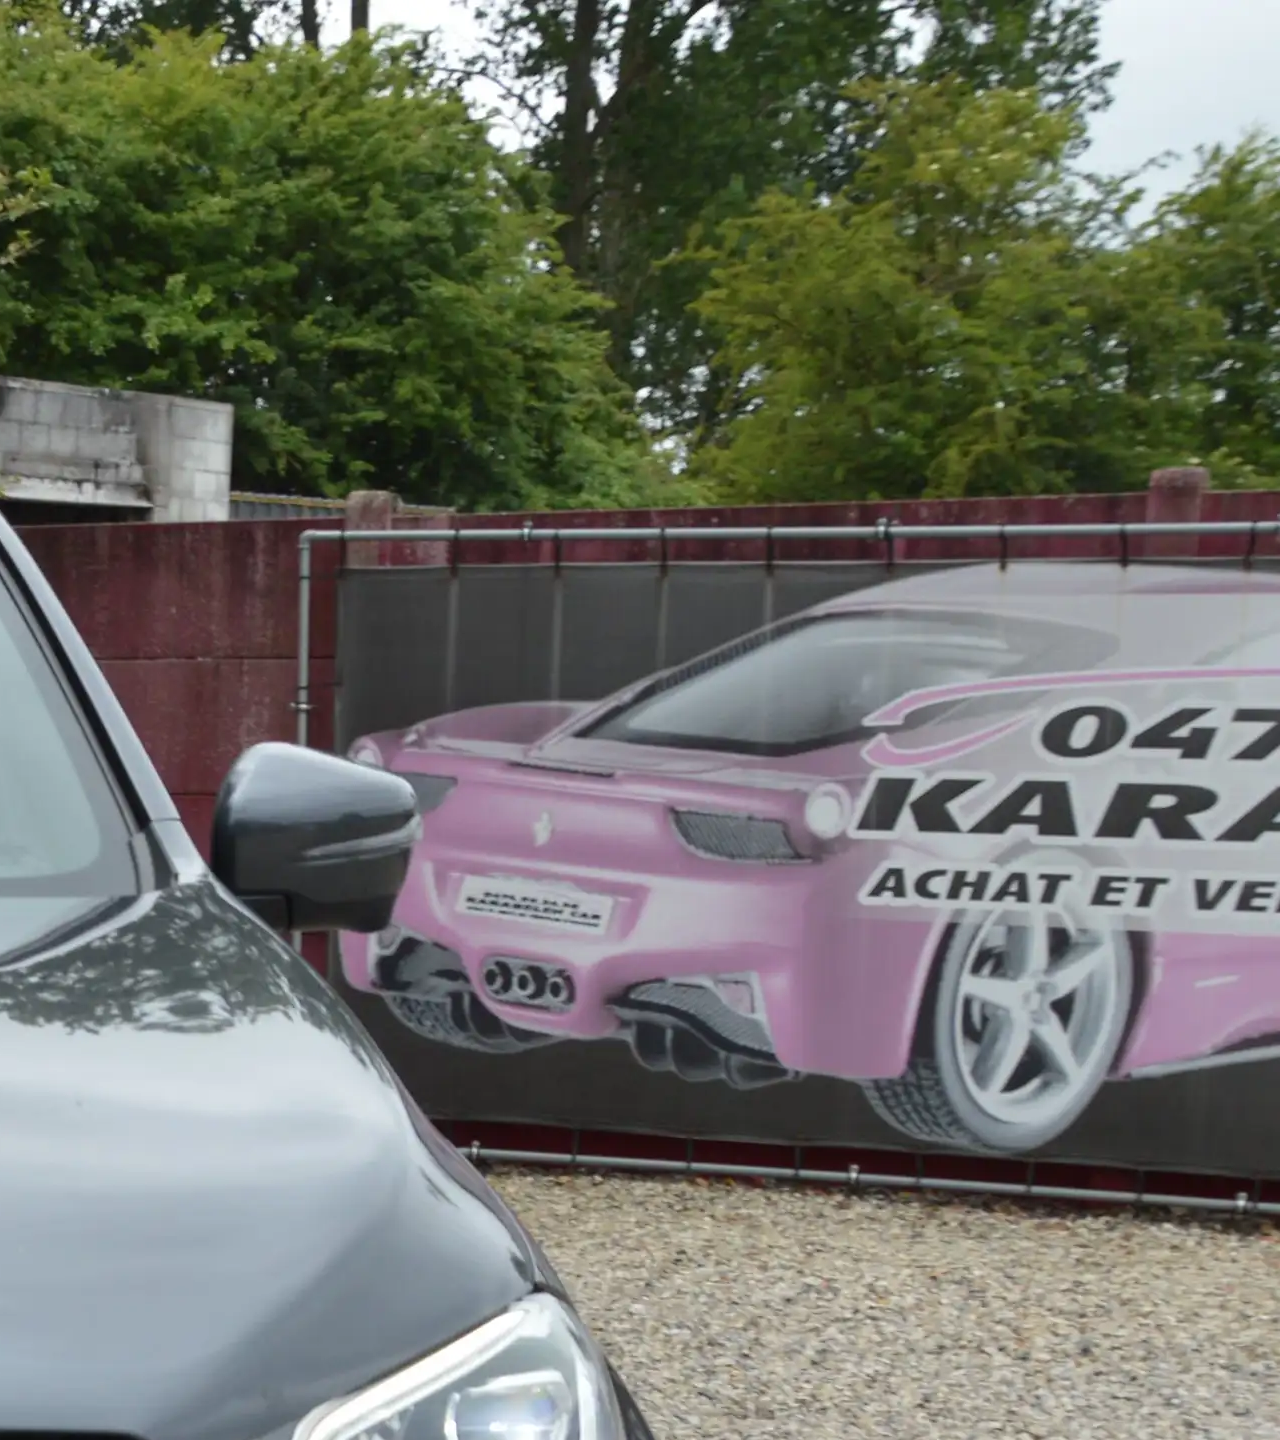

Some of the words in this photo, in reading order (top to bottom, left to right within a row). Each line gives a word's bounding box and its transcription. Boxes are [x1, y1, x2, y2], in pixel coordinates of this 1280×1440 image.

[867, 867, 1073, 904] ACHAT
[1090, 875, 1170, 908] ET
[1194, 878, 1280, 913] VE
